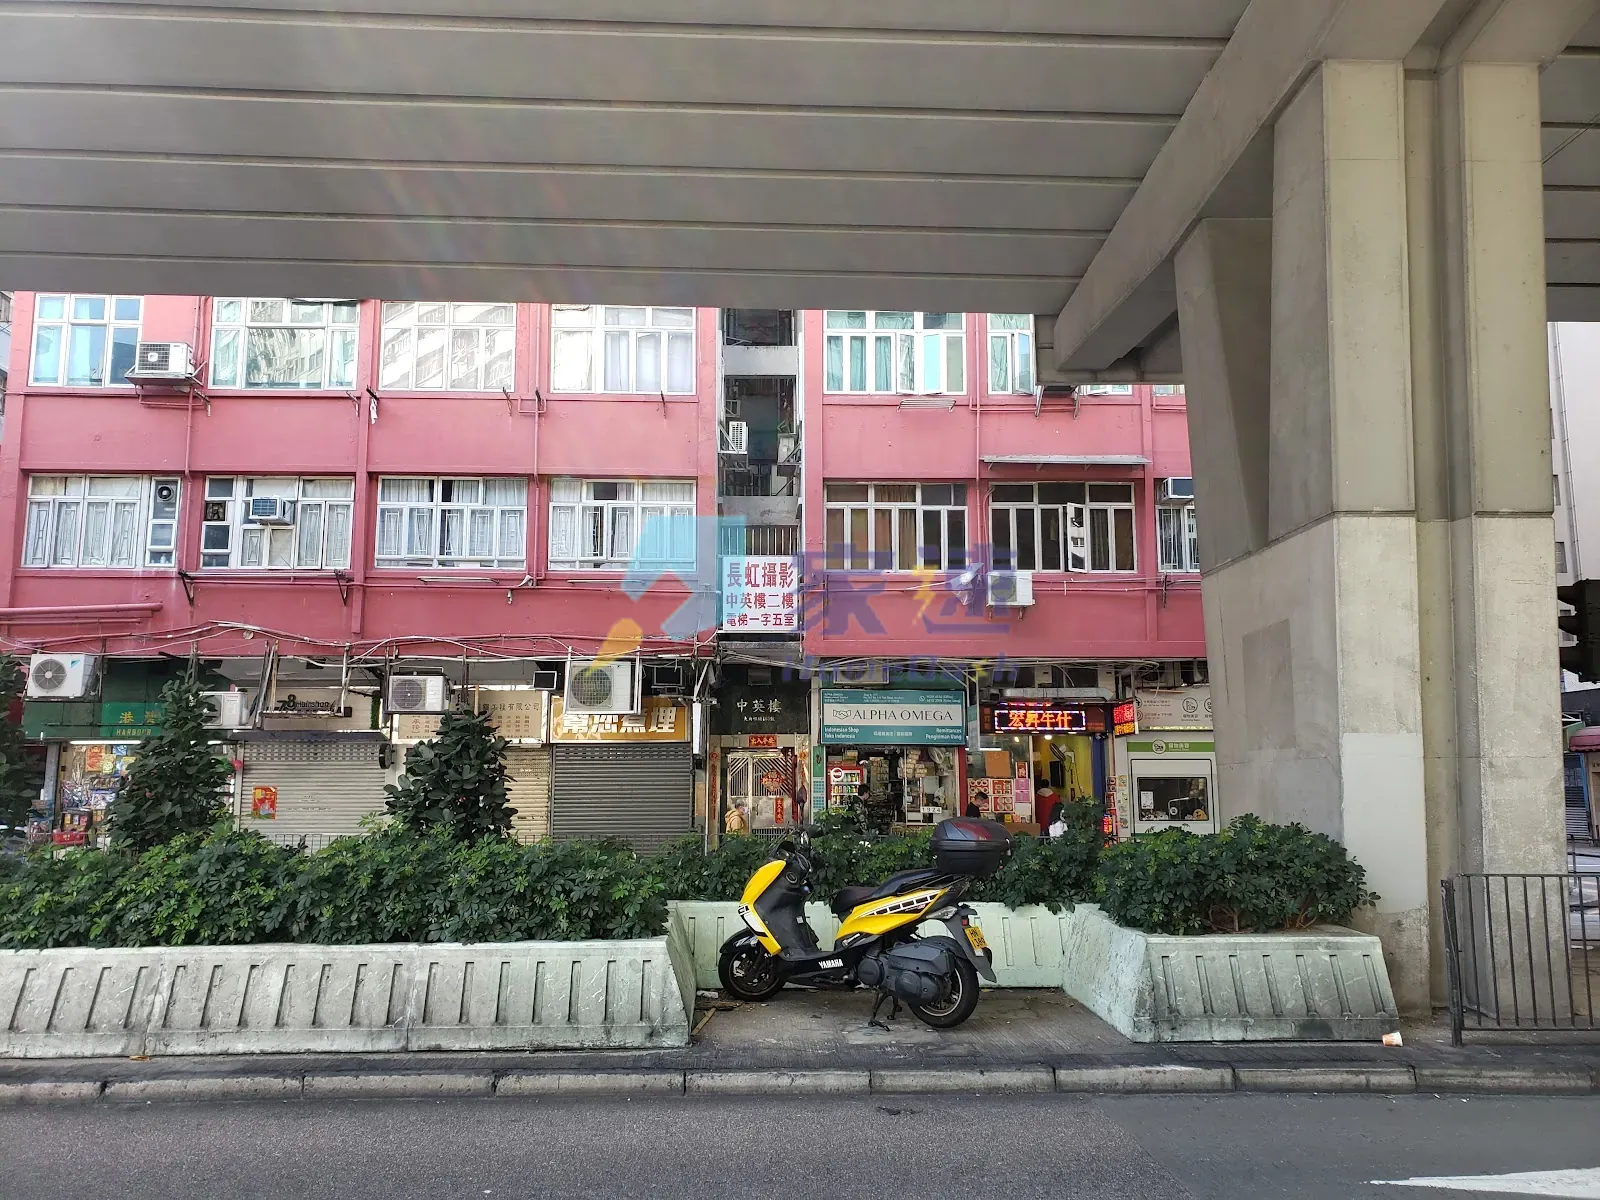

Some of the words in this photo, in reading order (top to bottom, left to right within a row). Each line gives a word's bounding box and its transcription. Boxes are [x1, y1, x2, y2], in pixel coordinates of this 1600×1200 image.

[727, 562, 794, 588] 長虹攝影
[726, 592, 795, 609] 中英樓二樓
[726, 613, 795, 626] 電梯一字五室
[736, 698, 783, 713] 中英樓
[852, 709, 897, 721] ALPHA
[900, 709, 953, 721] OMEGA
[847, 727, 860, 735] Shop
[818, 959, 844, 970] YAMAHA
